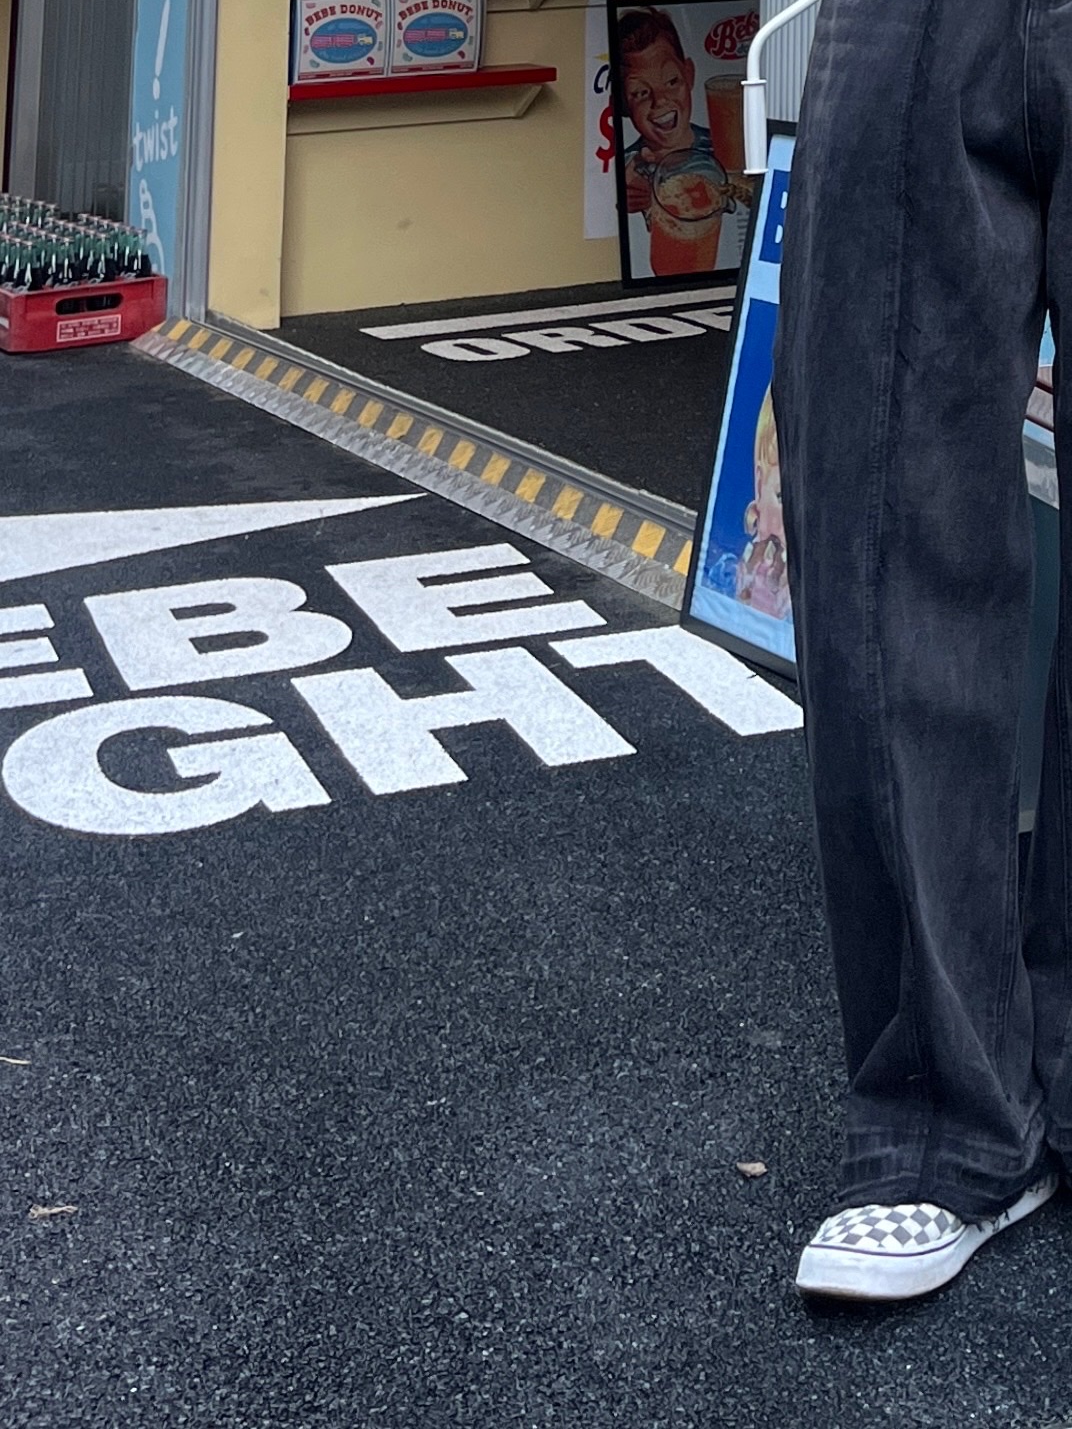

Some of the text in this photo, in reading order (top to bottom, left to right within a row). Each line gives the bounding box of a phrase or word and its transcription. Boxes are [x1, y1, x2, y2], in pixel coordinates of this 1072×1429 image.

[305, 4, 382, 26] BEBE DONUT
[398, 0, 473, 20] BEBE DONUT
[133, 105, 178, 171] twist
